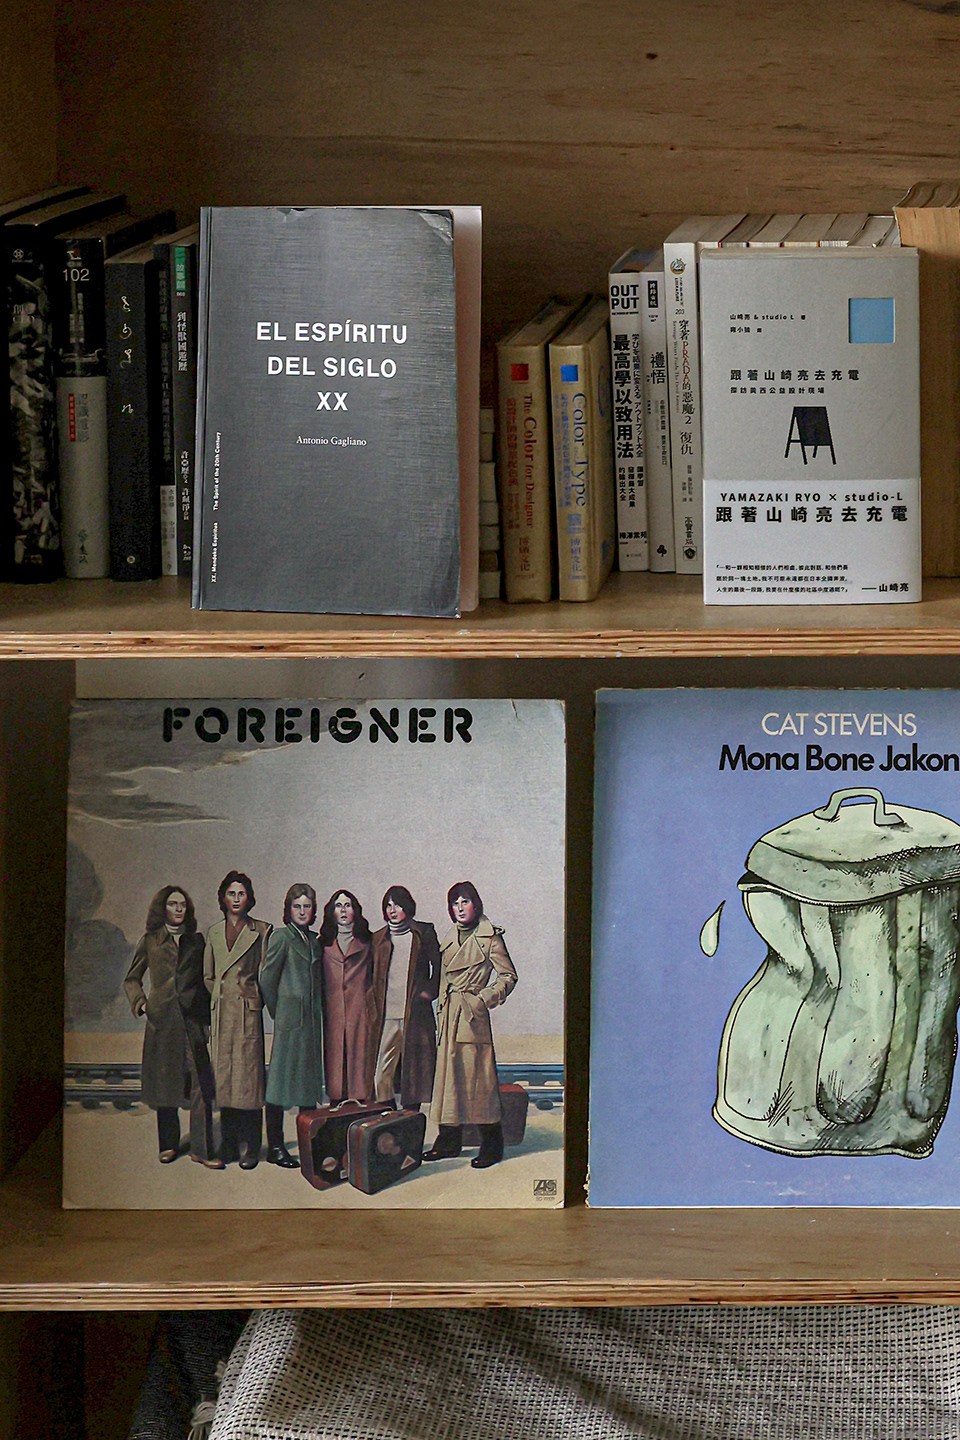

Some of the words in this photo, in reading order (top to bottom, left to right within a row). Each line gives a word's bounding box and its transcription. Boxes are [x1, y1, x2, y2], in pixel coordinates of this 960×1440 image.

[63, 268, 90, 282] 102
[611, 284, 639, 297] OUT
[612, 297, 640, 310] PUT
[256, 322, 287, 342] EL
[294, 319, 408, 344] ESPÍRITU
[267, 356, 315, 376] DEL
[323, 357, 397, 379] SIGLO
[730, 370, 859, 381] 跟著山崎亮去充電
[316, 392, 348, 411] XX
[523, 394, 534, 413] The
[613, 334, 635, 459] 最高學以致用法
[572, 393, 587, 446] Color
[296, 435, 329, 446] Antonio
[331, 436, 367, 448] Gagliano
[523, 417, 537, 461] Color
[525, 465, 534, 478] for
[571, 456, 589, 507] Type
[524, 483, 535, 528] Designer
[721, 493, 789, 502] YAMAZAKI
[796, 493, 821, 501] RYO
[845, 492, 903, 501] studio-L
[716, 506, 908, 523] 跟著山崎亮去充電
[163, 707, 474, 744] FOREIGNER
[761, 712, 810, 737] CAT
[813, 713, 917, 737] STEVENS
[719, 744, 800, 772] Mona
[805, 745, 875, 772] Bone
[878, 745, 960, 772] Jakon
